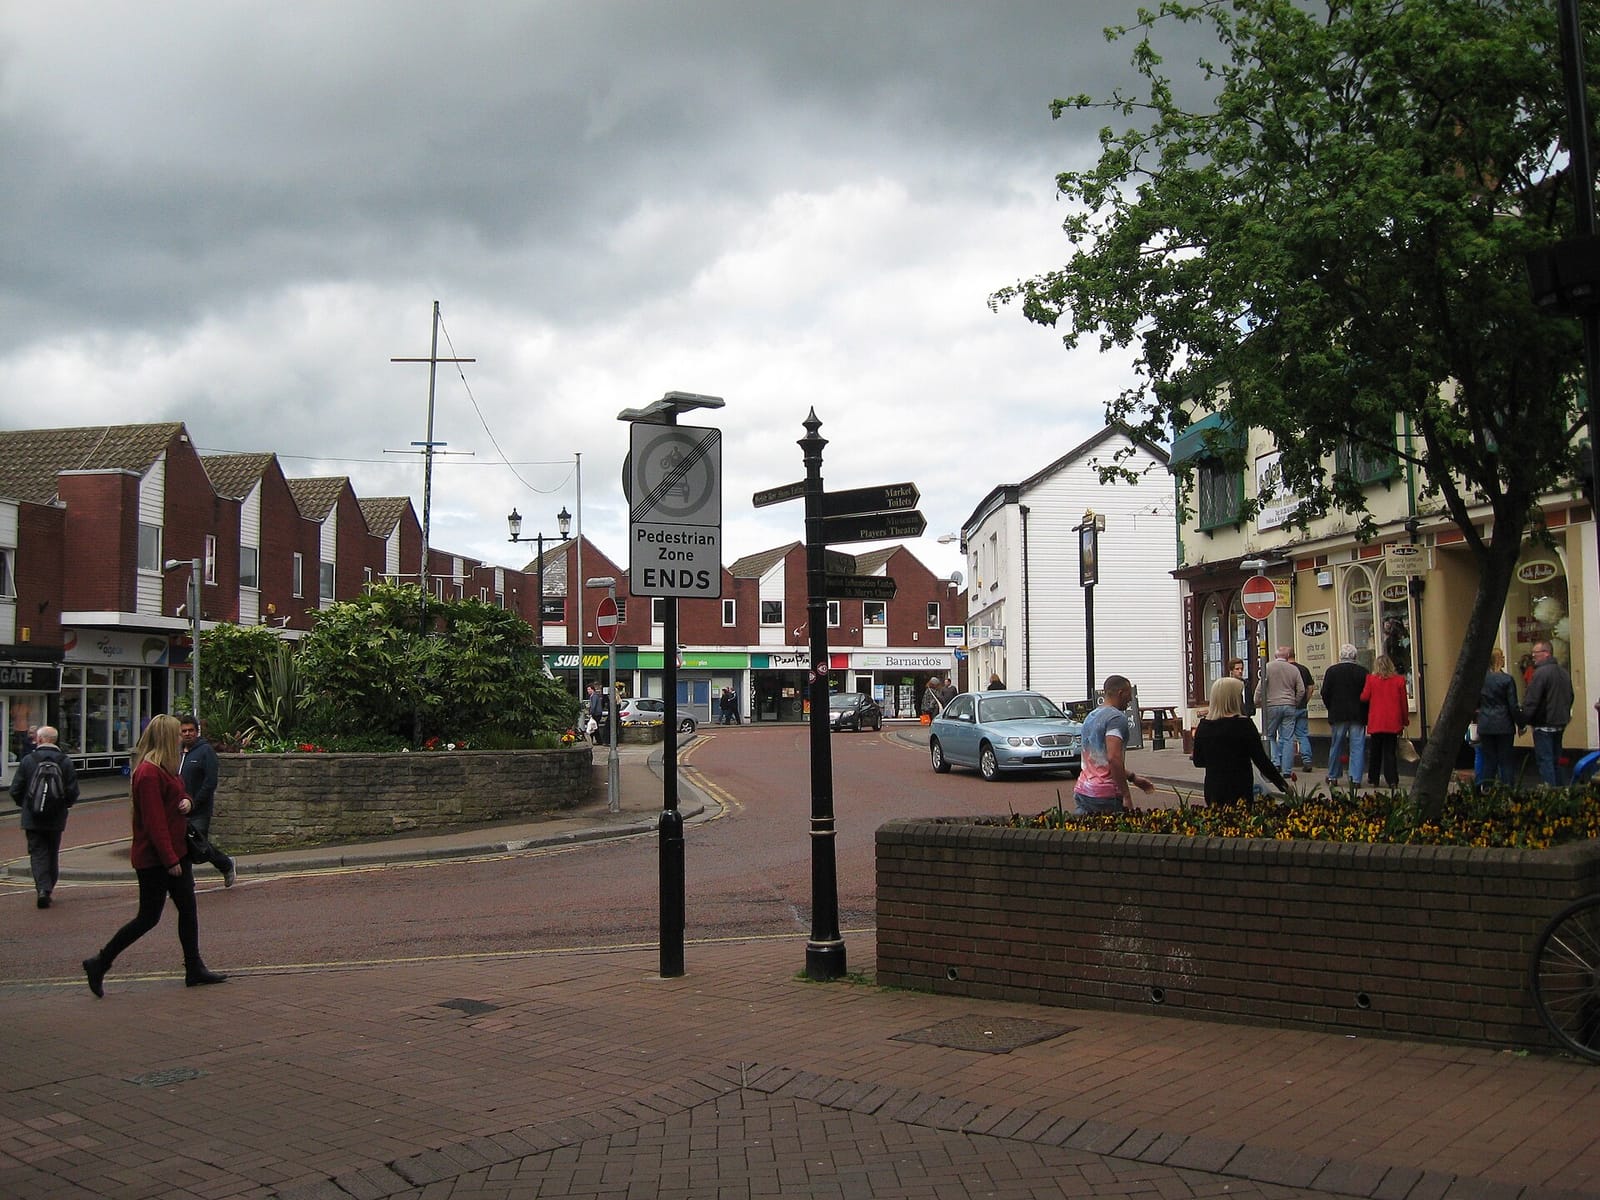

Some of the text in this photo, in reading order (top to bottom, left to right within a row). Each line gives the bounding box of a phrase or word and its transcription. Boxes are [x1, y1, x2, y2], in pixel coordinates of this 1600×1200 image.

[885, 487, 912, 498] Market
[888, 498, 913, 509] Toilets
[889, 526, 919, 536] Theatre
[637, 529, 715, 546] Pedestrian
[658, 547, 694, 561] Zone
[643, 568, 710, 590] ENDS
[886, 656, 942, 666] Barnardo's
[0, 667, 33, 684] GATE
